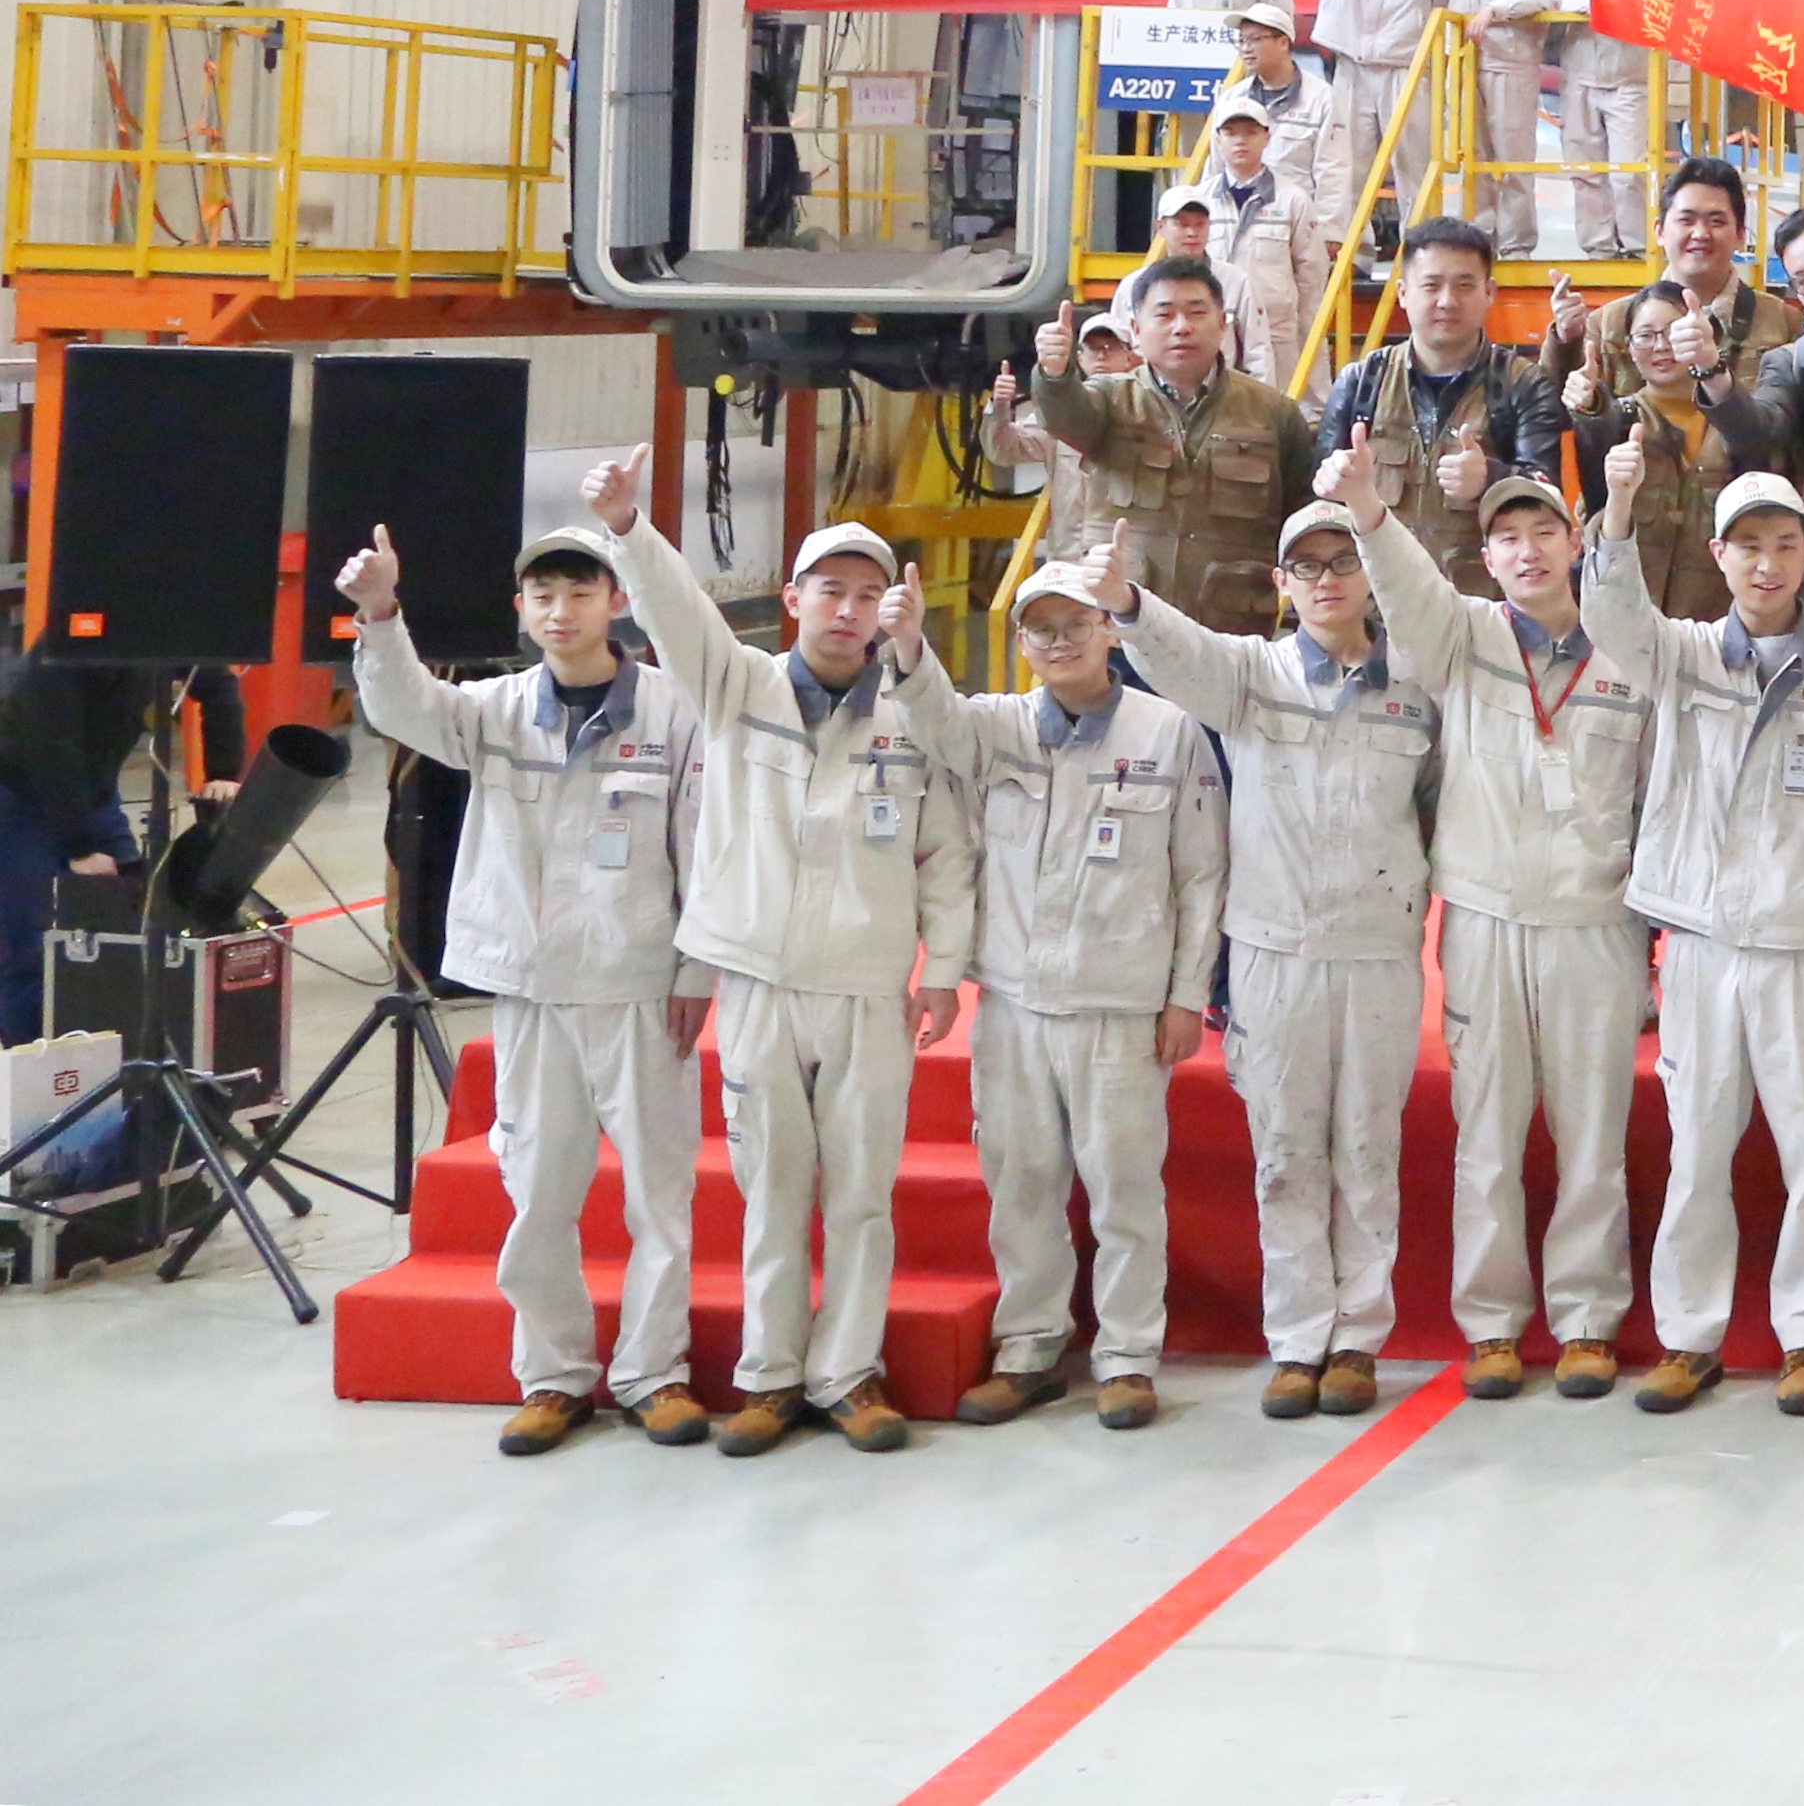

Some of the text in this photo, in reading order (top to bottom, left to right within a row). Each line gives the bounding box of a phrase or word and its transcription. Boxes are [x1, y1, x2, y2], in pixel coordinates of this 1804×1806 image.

[1146, 23, 1237, 45] 生产流水线
[1108, 77, 1177, 101] A2207
